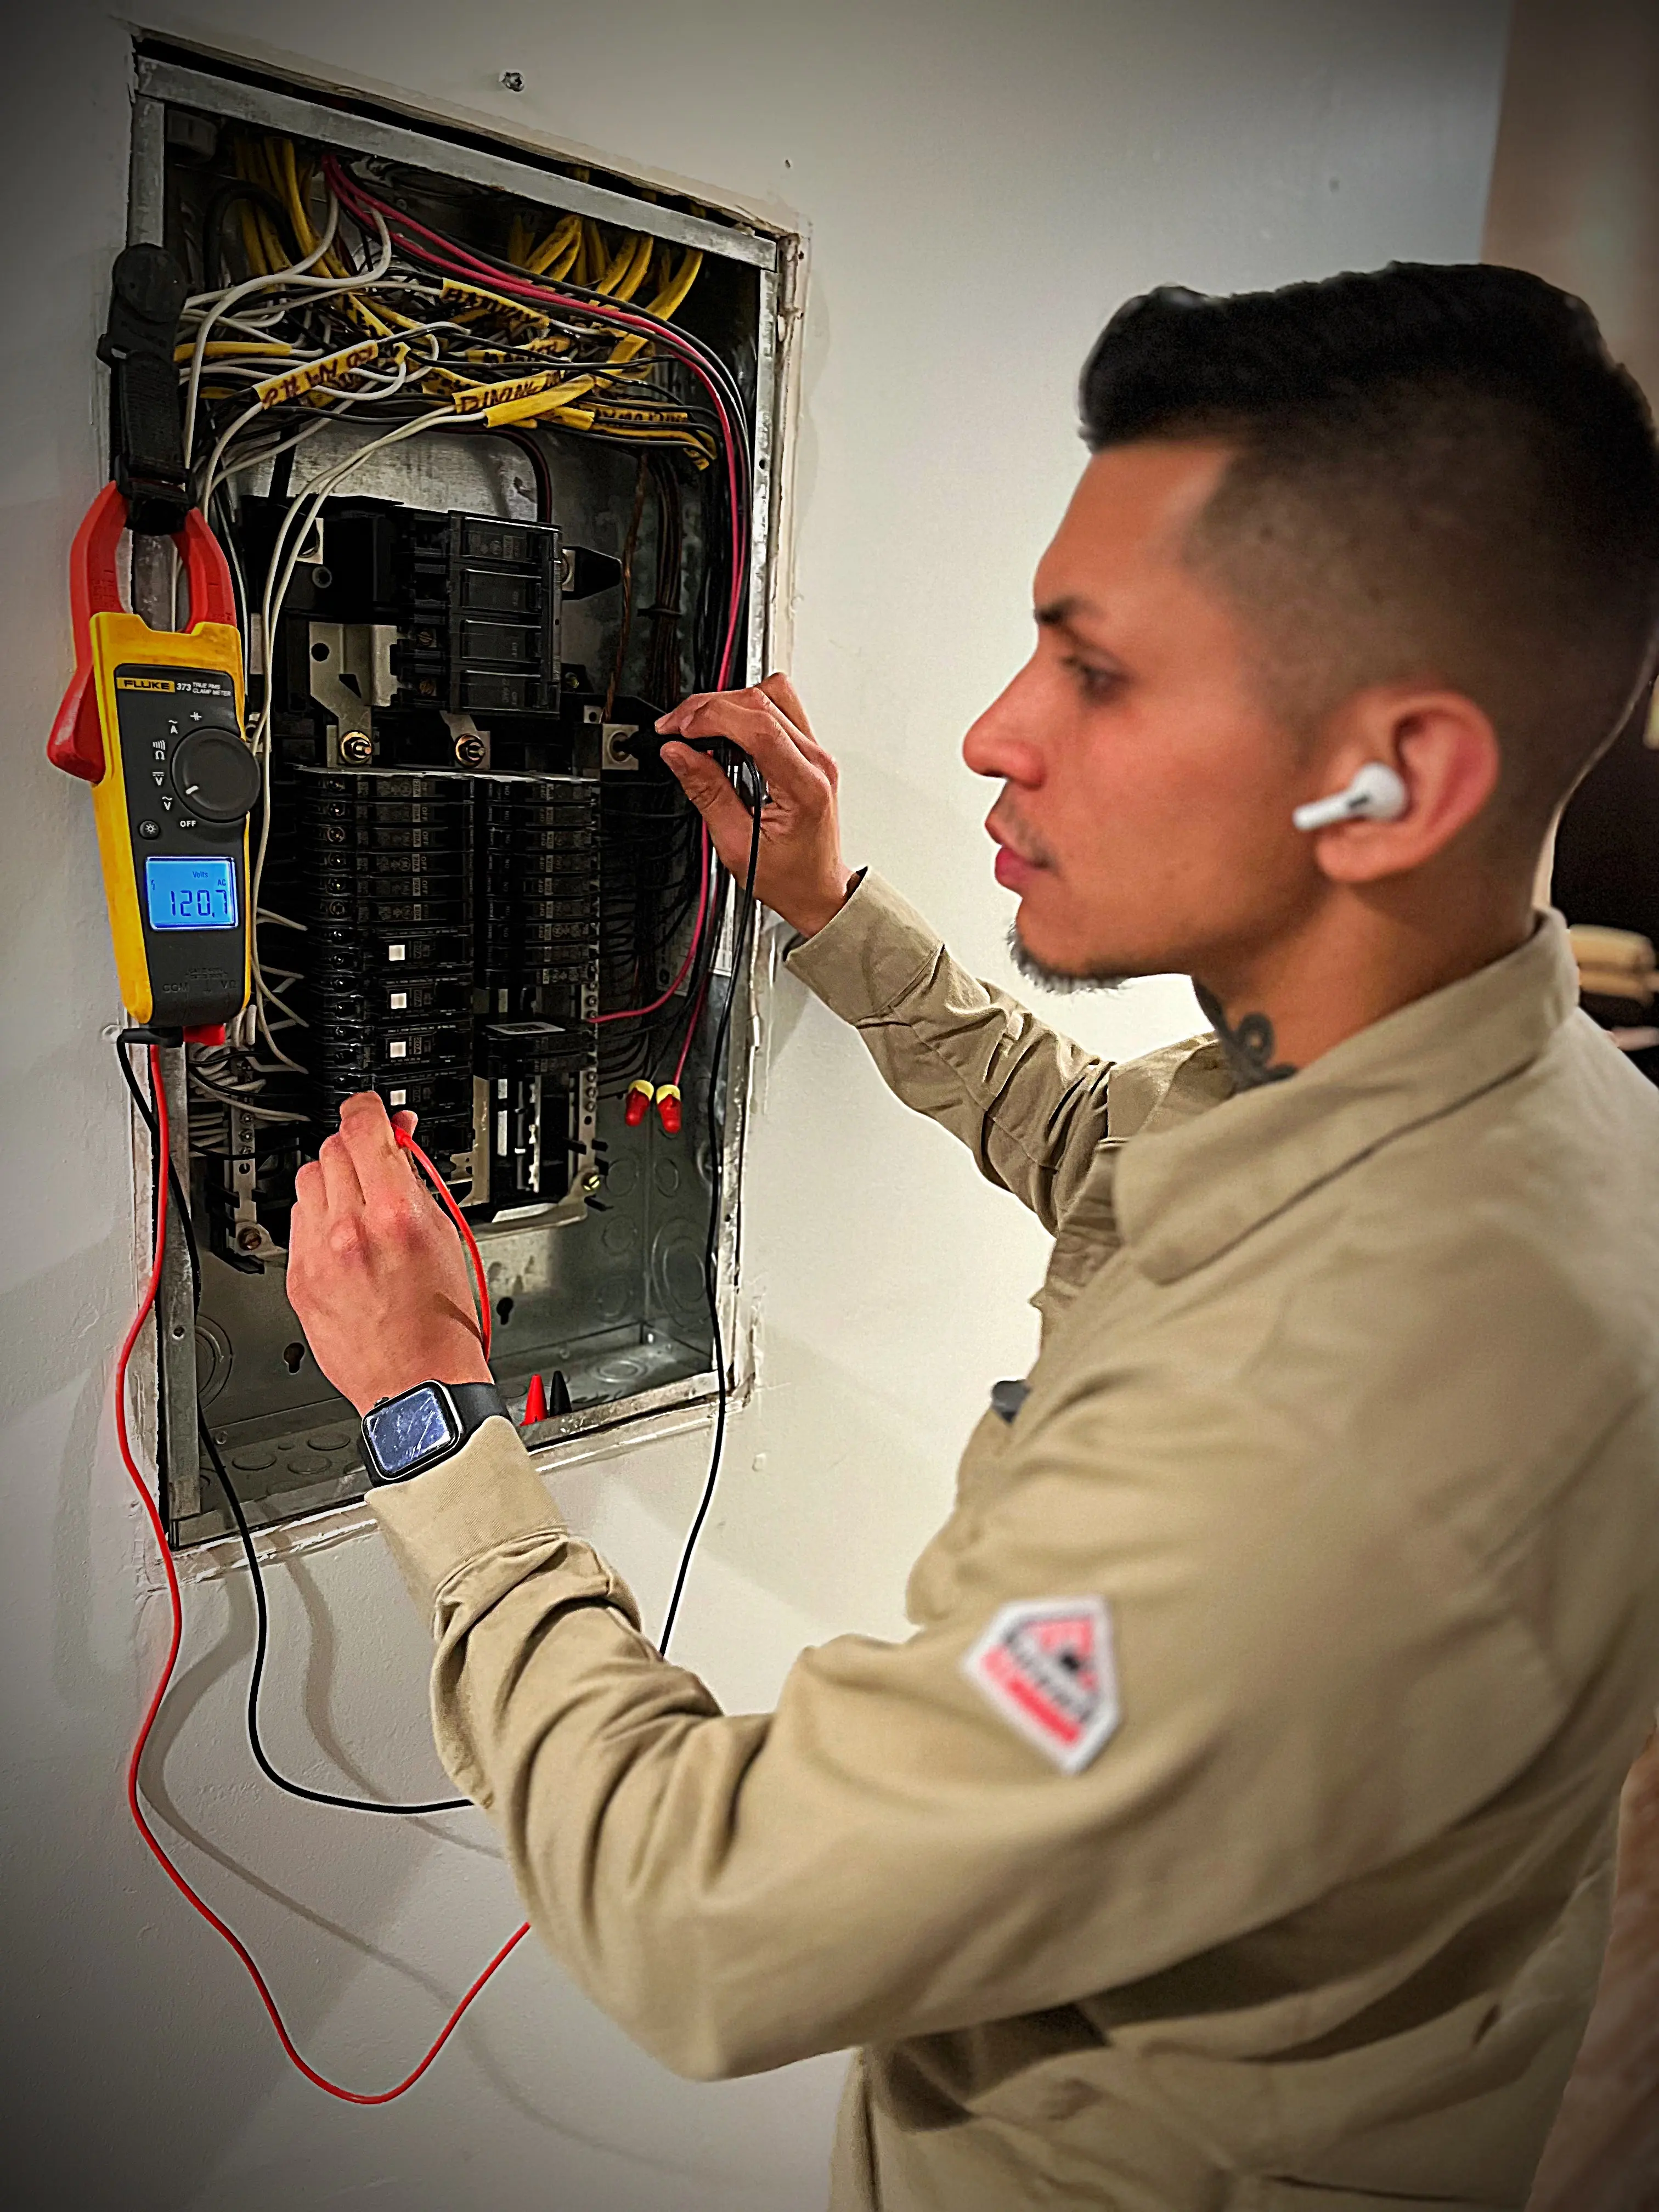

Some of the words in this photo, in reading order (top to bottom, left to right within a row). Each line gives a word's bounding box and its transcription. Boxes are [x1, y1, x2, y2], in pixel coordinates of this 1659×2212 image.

[124, 680, 170, 690] FLUKE
[176, 682, 191, 691] 373
[171, 890, 228, 917] 120.7
[162, 981, 188, 992] COM
